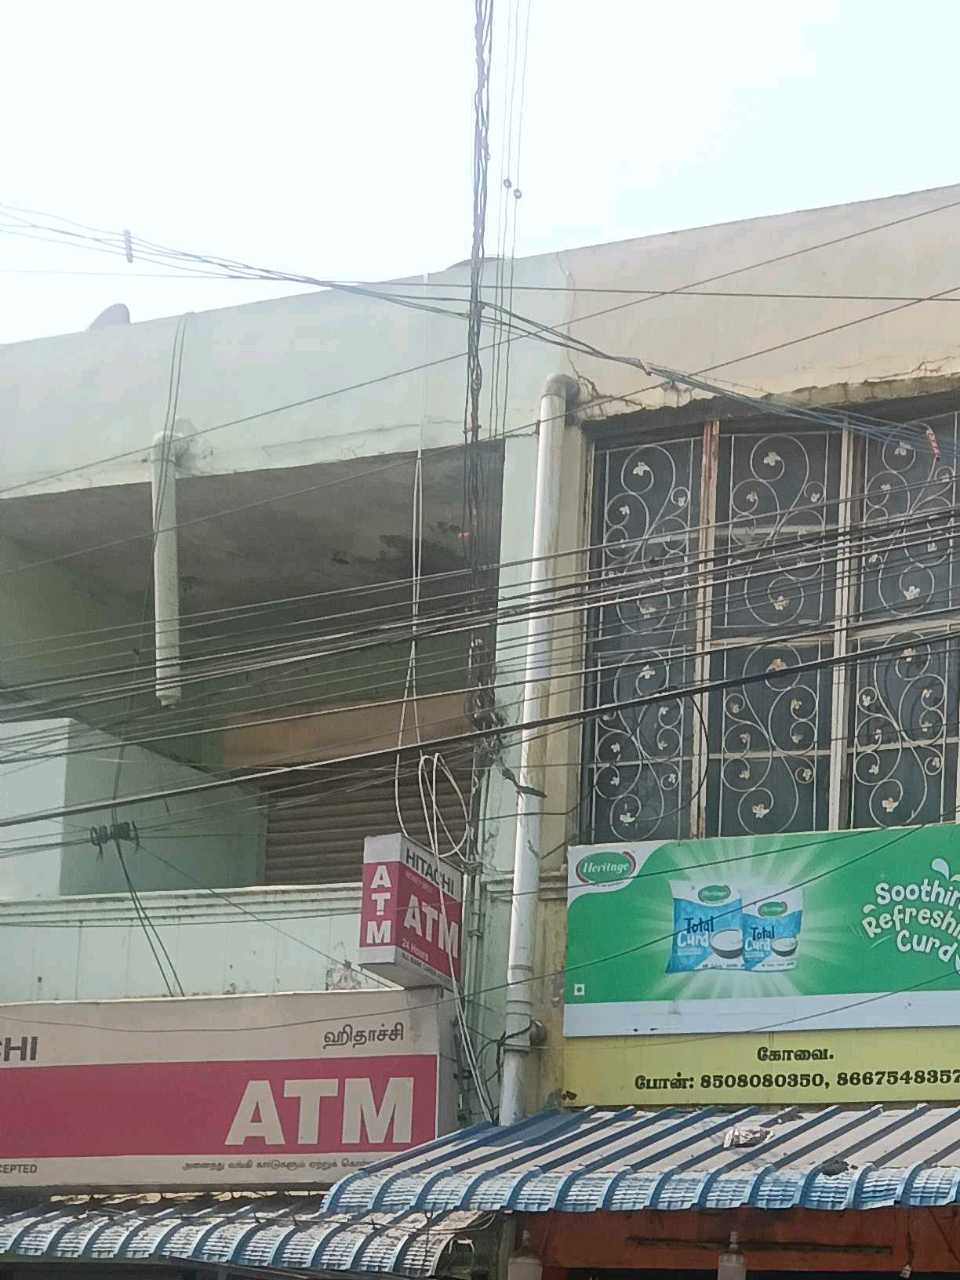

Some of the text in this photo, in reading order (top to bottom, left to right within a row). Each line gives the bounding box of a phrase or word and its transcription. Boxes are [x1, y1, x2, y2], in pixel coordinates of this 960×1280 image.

[405, 848, 454, 895] HITACHI
[583, 862, 630, 874] Heritage
[366, 865, 392, 944] ATM
[404, 894, 459, 959] ATM
[683, 916, 715, 934] Total
[751, 925, 776, 941] Total
[677, 930, 709, 948] Curd
[744, 936, 770, 952] Curd
[896, 929, 959, 963] Curd
[322, 1022, 404, 1049] ஹிதாச்சி
[0, 1036, 38, 1061] HI
[757, 1046, 834, 1063] கோவை.
[699, 1074, 830, 1090] 8508080350,
[224, 1076, 415, 1146] ATM
